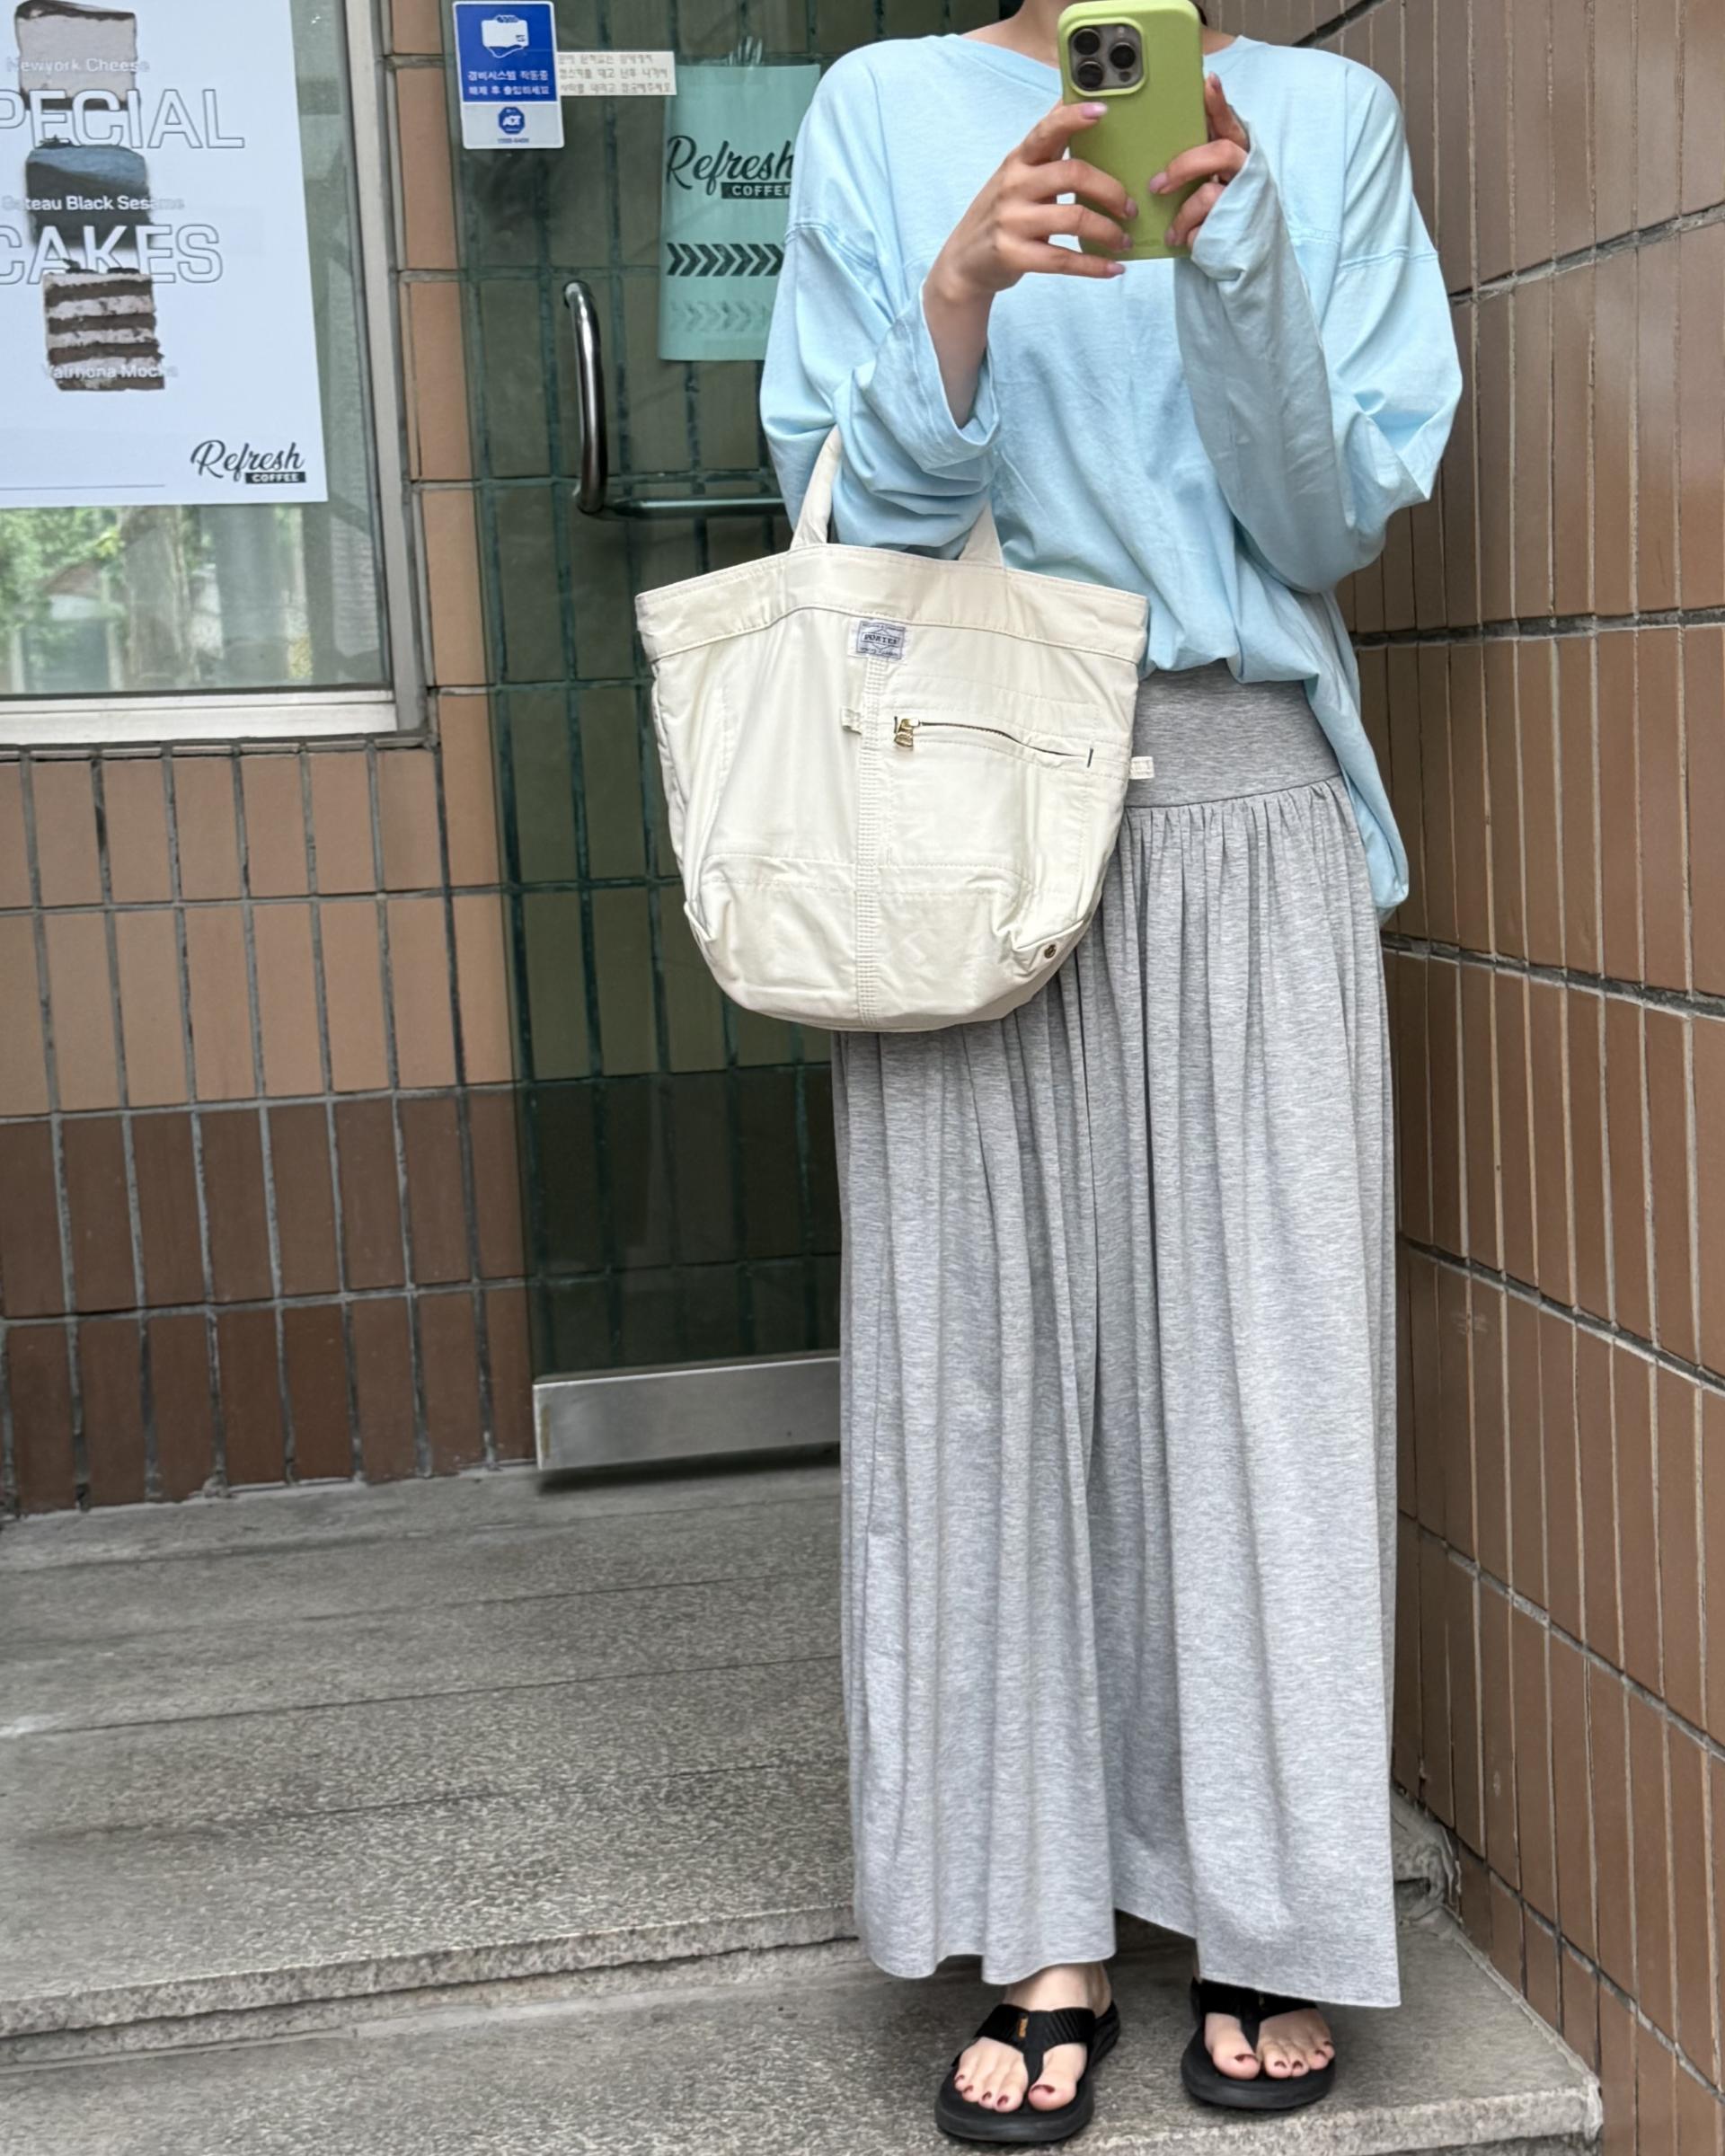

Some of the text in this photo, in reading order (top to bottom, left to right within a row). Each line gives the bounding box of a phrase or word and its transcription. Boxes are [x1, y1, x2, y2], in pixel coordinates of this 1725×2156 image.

[666, 135, 794, 196] Refresh
[66, 195, 114, 210] Black
[190, 439, 305, 482] Refresh
[252, 473, 300, 482] COFFEE
